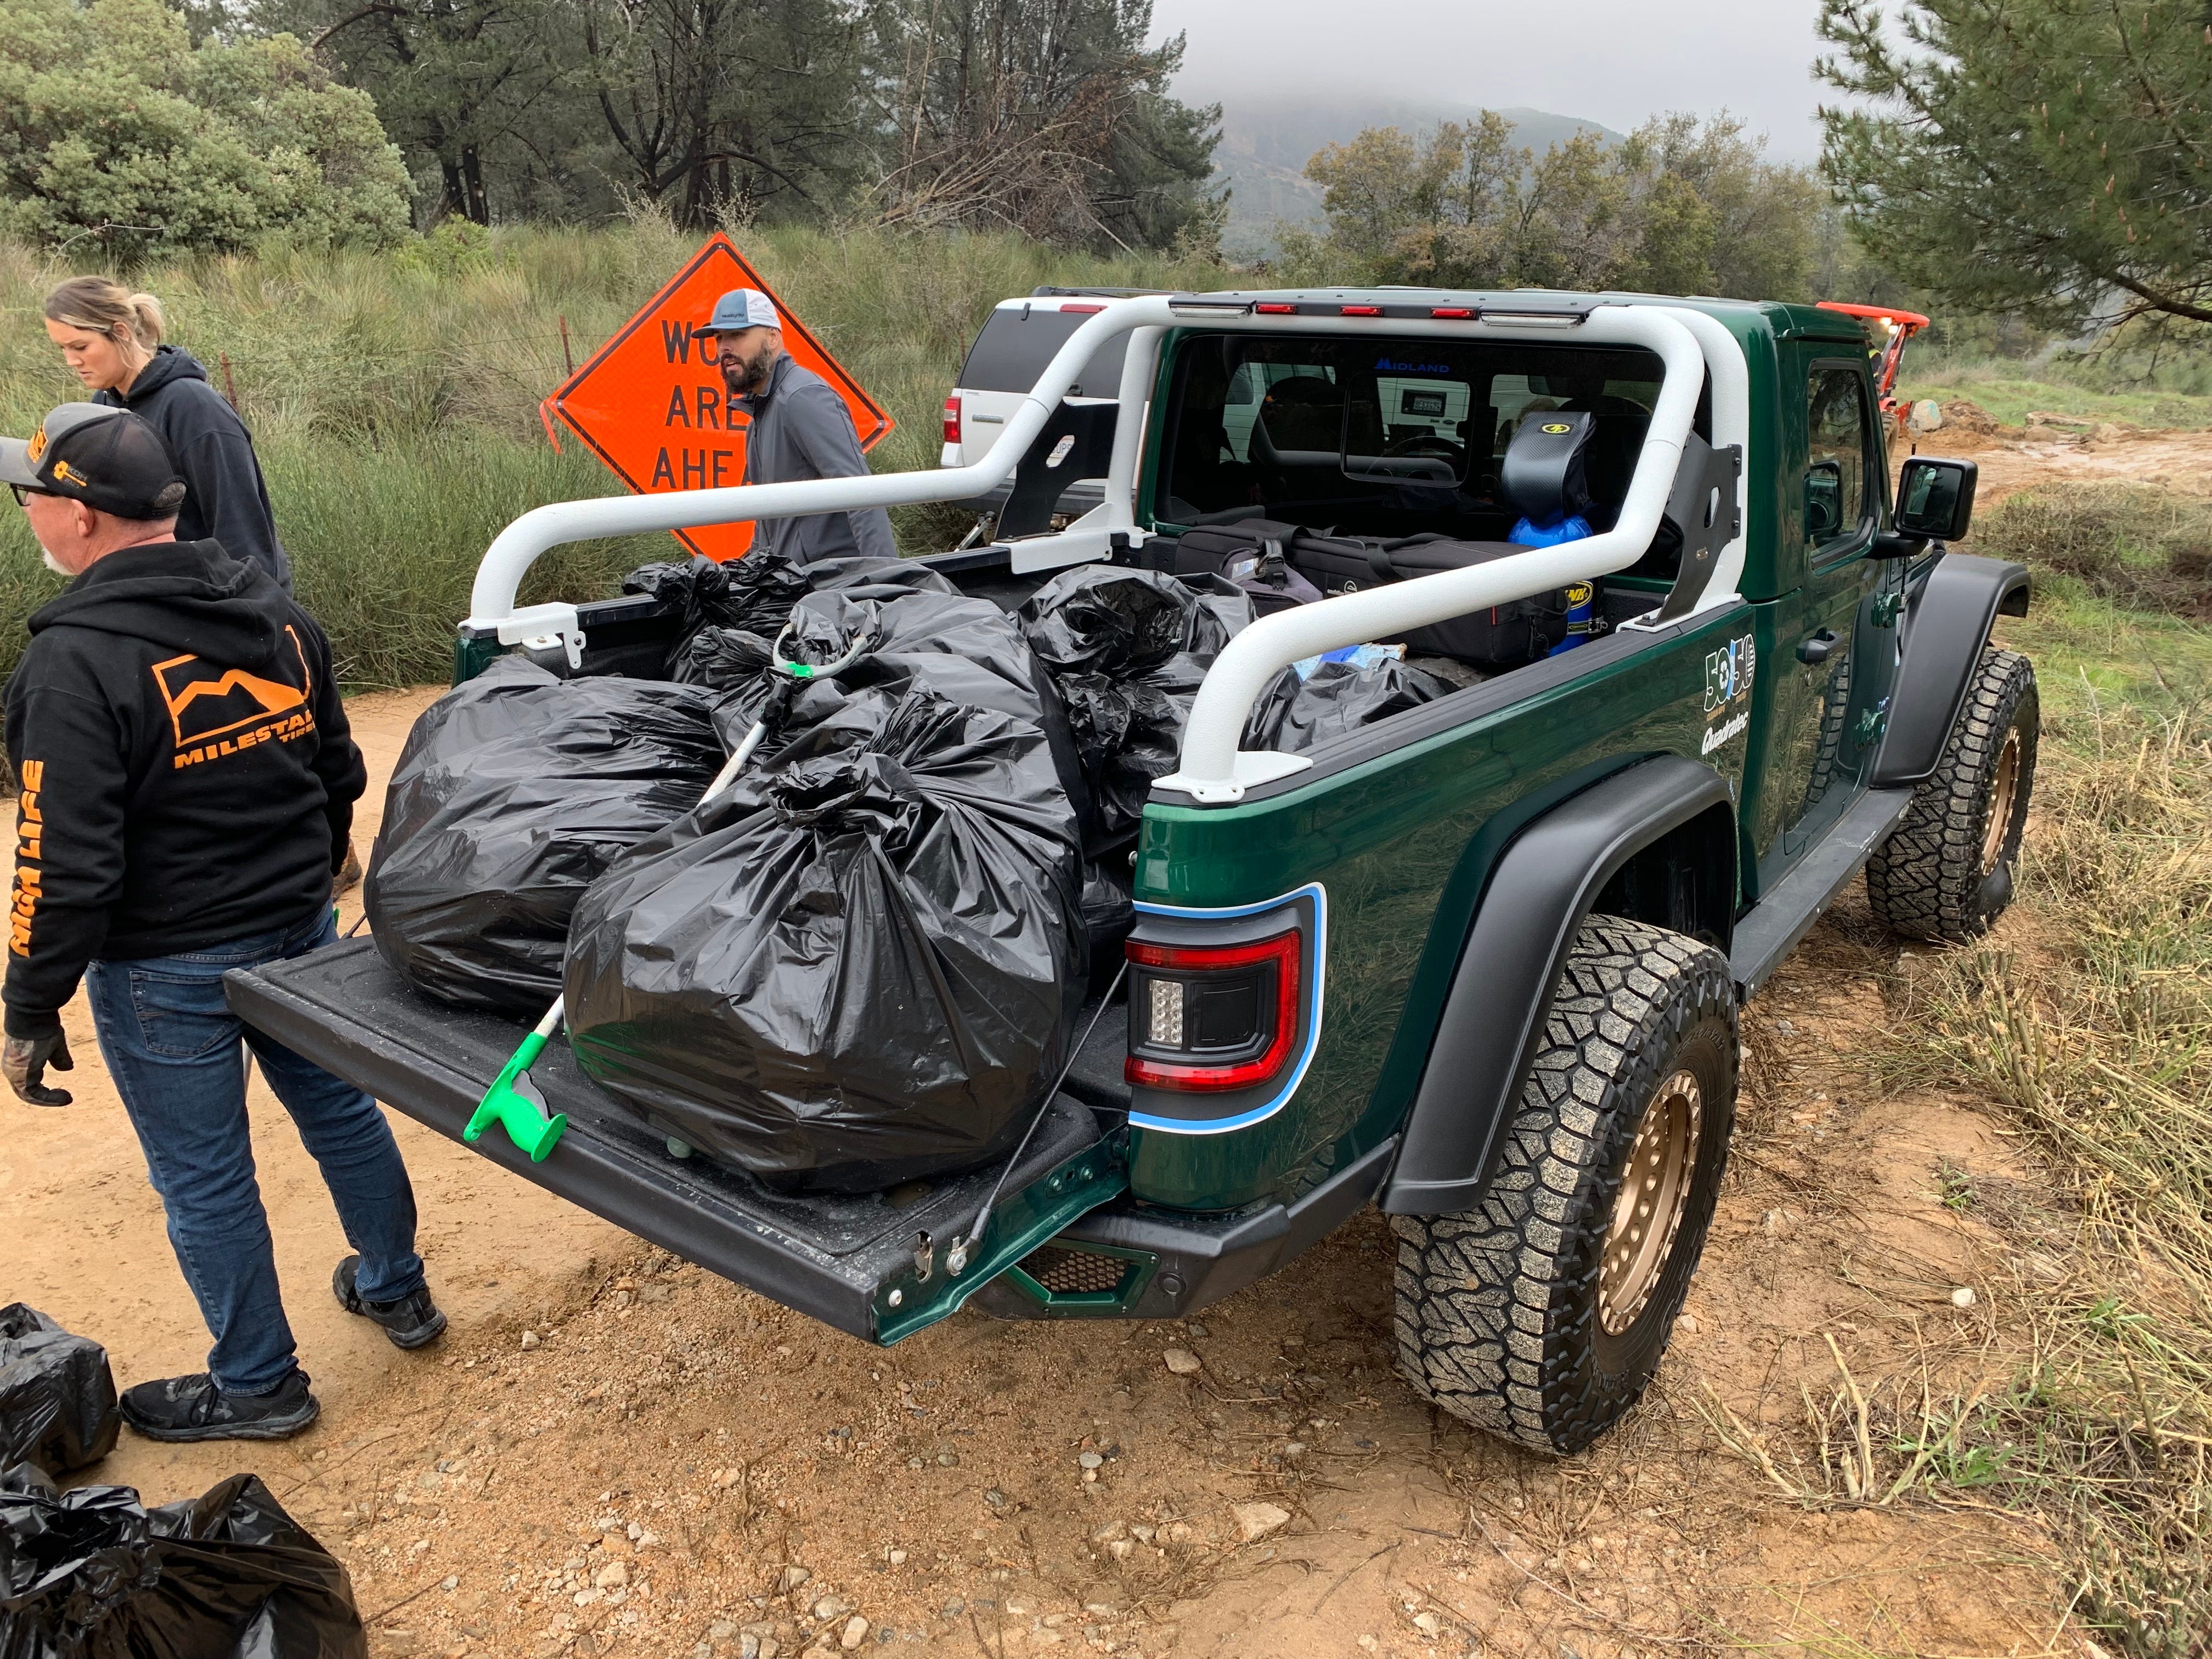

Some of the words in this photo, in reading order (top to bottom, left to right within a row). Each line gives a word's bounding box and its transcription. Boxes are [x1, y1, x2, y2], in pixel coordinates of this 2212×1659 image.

[661, 320, 720, 366] WO
[1374, 357, 1450, 373] MIDLAND
[665, 385, 747, 431] ARE
[651, 447, 753, 490] AHE
[279, 720, 315, 743] TIRE
[1701, 710, 1749, 755] Quadratec
[18, 759, 44, 860] LIFE
